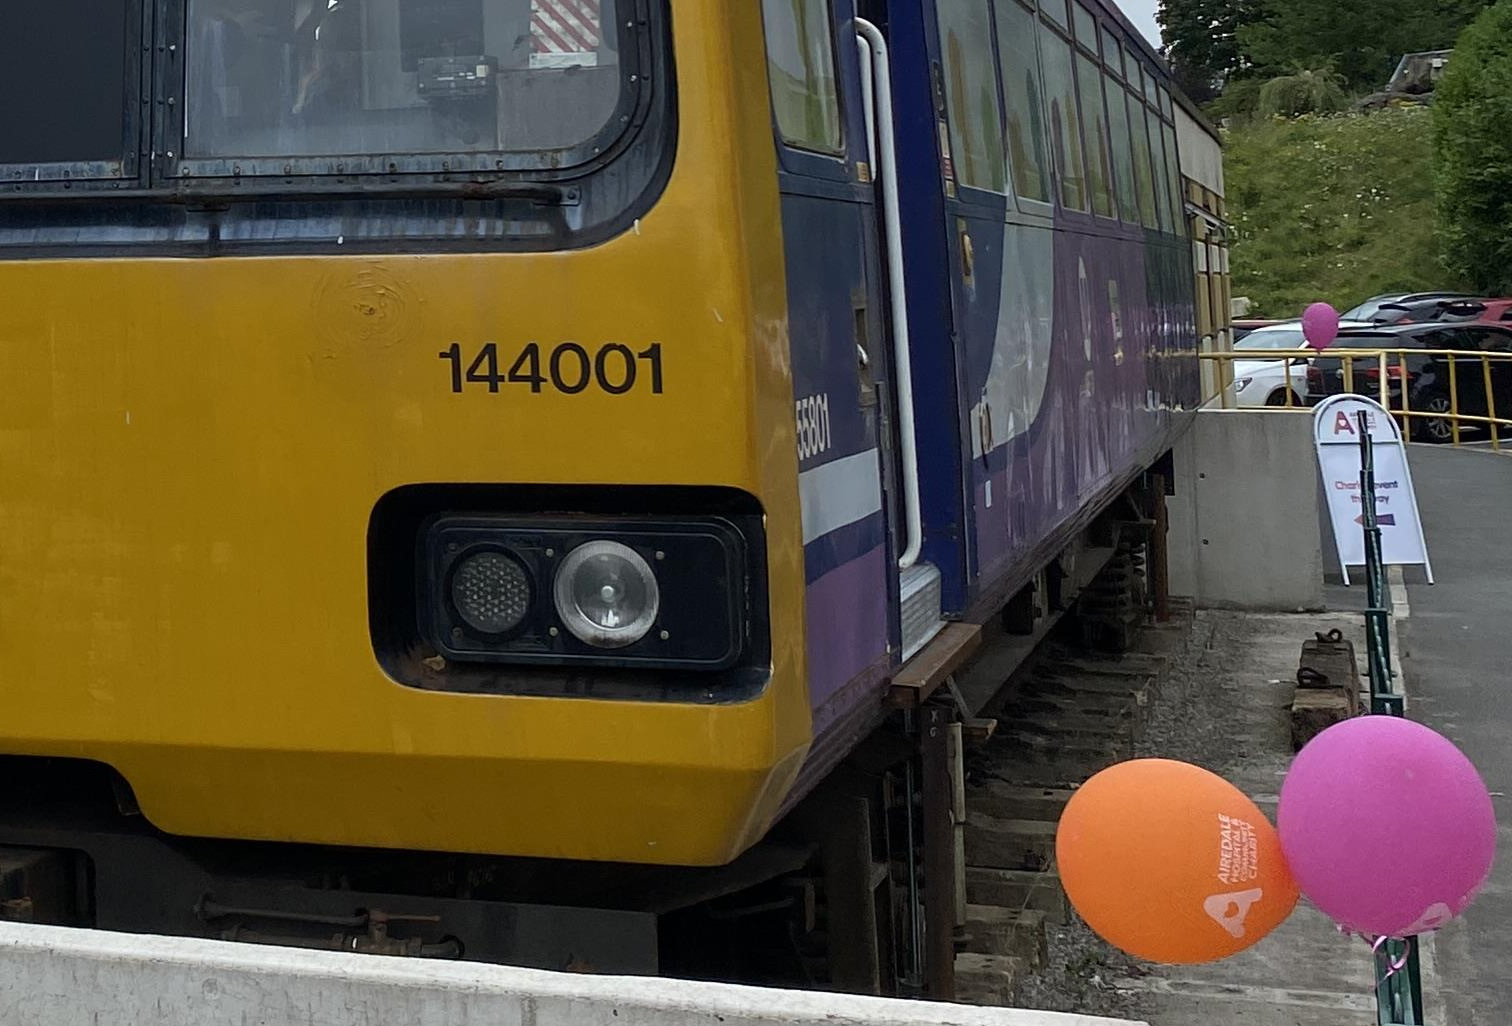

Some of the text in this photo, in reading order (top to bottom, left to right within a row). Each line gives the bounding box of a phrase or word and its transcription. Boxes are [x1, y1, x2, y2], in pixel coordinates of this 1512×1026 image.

[439, 342, 664, 394] 144001
[796, 394, 831, 460] 55801
[1218, 813, 1233, 885] AIREDALE
